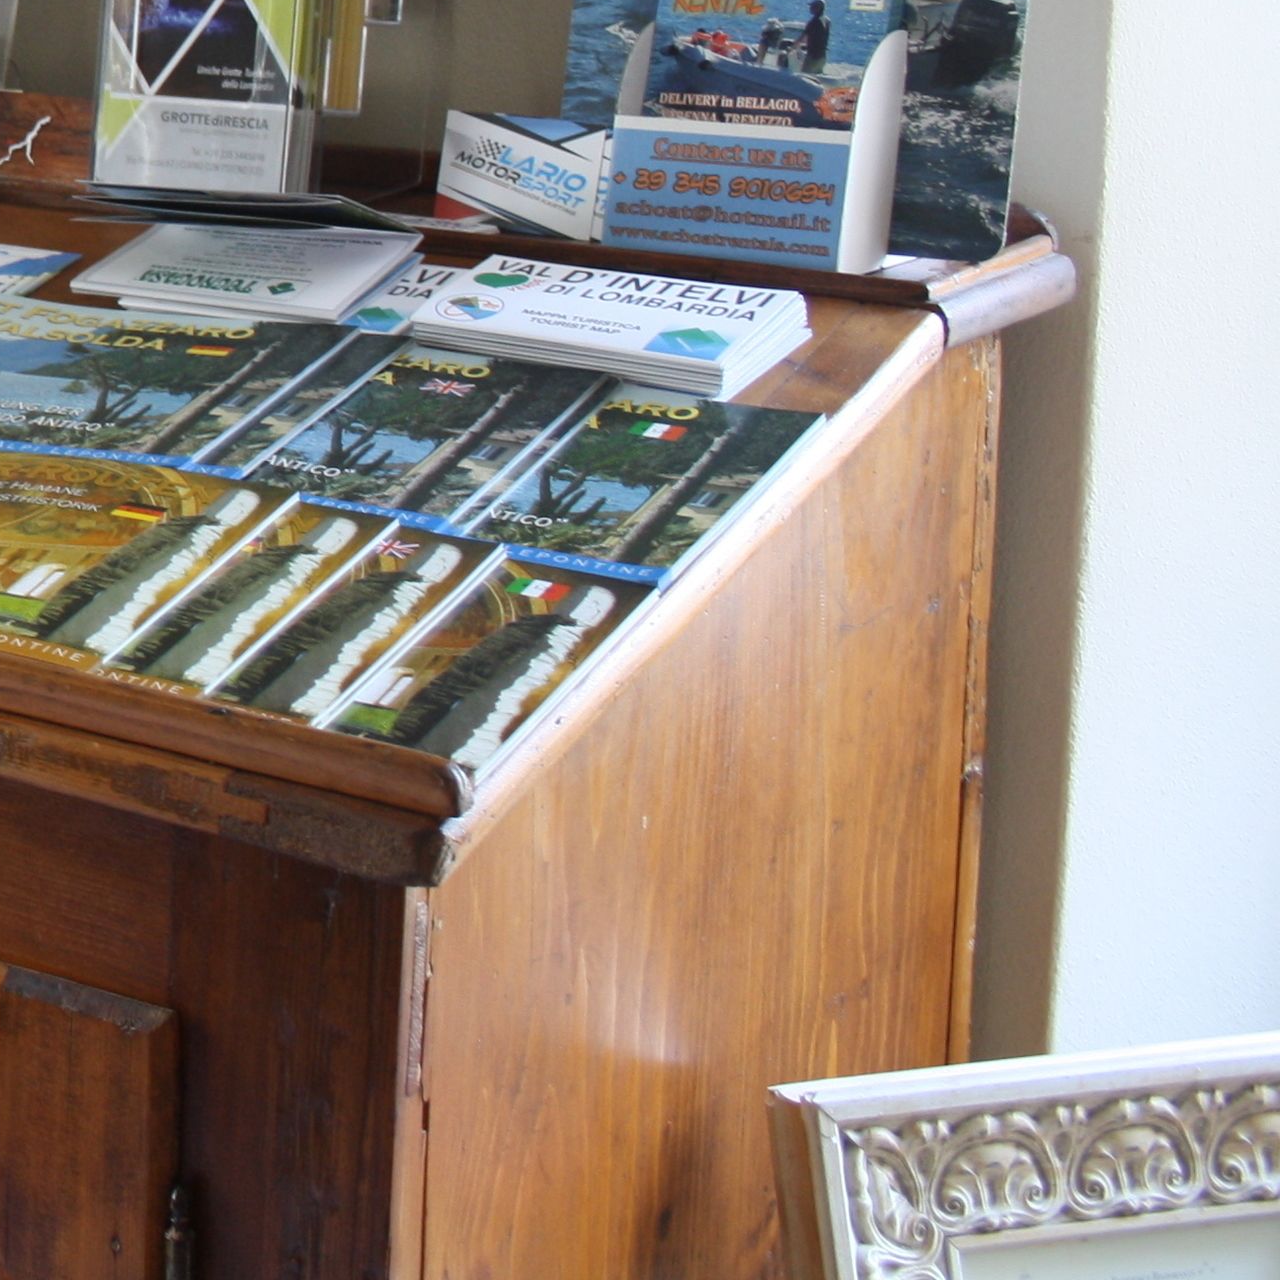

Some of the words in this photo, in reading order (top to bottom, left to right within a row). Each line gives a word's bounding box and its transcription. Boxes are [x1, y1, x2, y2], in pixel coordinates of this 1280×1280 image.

[658, 92, 720, 107] DELIVERY
[721, 95, 734, 107] in
[736, 95, 802, 113] BELLAGIO,
[652, 136, 745, 162] Contact
[748, 148, 776, 165] us
[781, 149, 813, 168] at:
[453, 150, 588, 209] MOTORSPORT
[499, 146, 588, 193] LARIO
[633, 167, 668, 192] 39
[672, 171, 722, 197] 345
[728, 176, 835, 205] 9010694
[498, 259, 552, 278] VAL
[560, 269, 777, 308] D'INTELVI
[521, 307, 568, 320] MAPPA
[543, 283, 575, 296] DI
[579, 287, 757, 322] LOMBARDIA
[22, 305, 255, 340] FOGAZZARO
[529, 317, 587, 332] TOURIST
[589, 326, 622, 335] MAP
[44, 404, 86, 418] DER
[13, 480, 90, 498] HUMANE
[307, 497, 432, 525] EPONTINE
